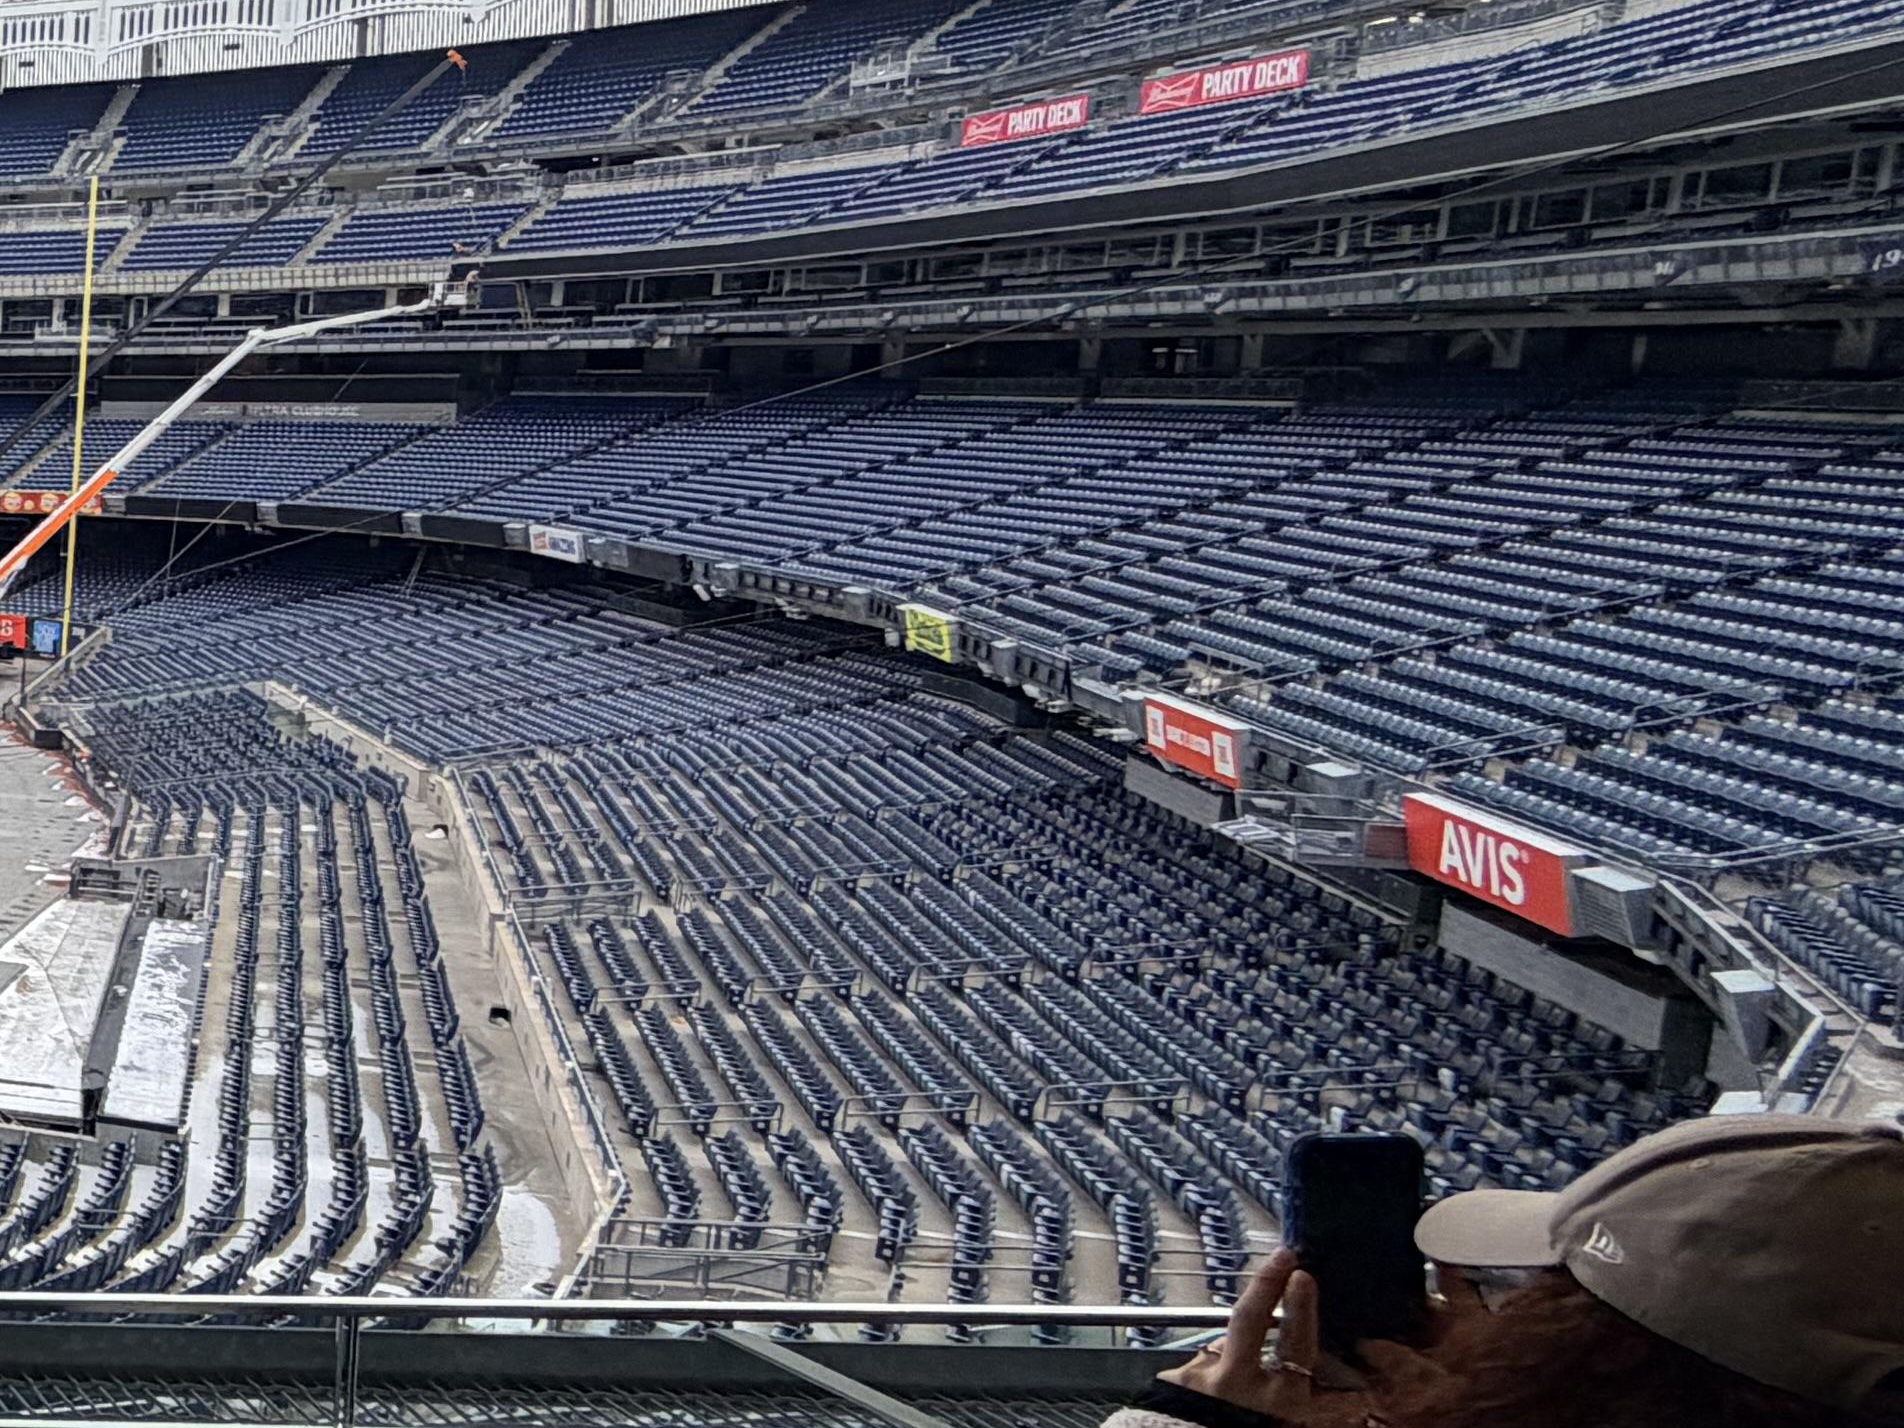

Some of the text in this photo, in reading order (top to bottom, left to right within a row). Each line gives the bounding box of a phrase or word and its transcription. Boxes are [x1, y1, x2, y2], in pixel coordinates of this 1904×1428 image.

[1201, 64, 1253, 99] PARTY
[1255, 56, 1301, 89] DECK
[1007, 112, 1044, 136] PARTY
[1046, 101, 1083, 126] DECK
[1439, 819, 1526, 906] AVIS
